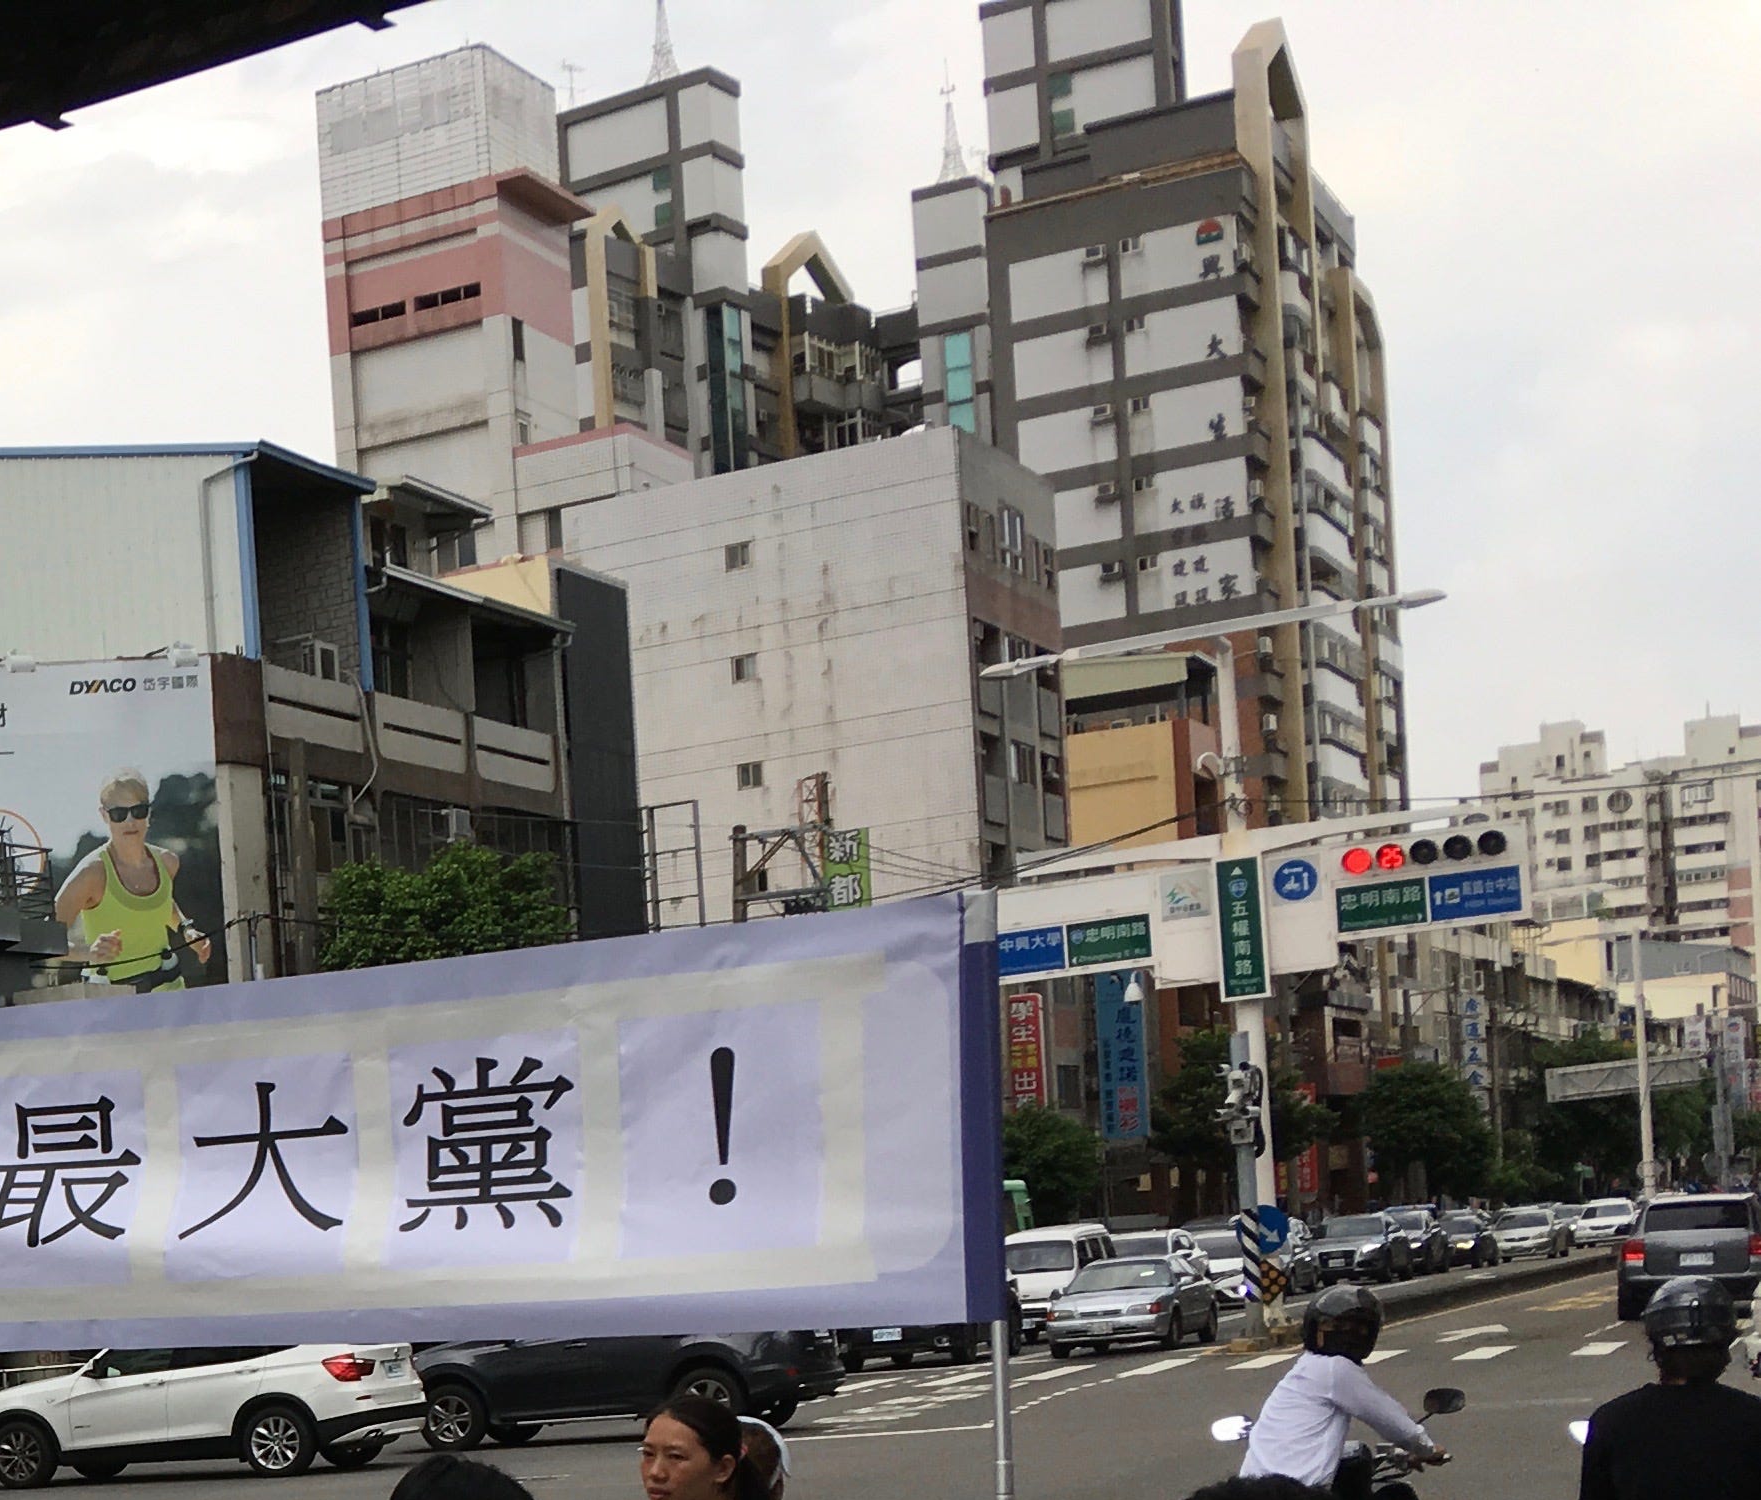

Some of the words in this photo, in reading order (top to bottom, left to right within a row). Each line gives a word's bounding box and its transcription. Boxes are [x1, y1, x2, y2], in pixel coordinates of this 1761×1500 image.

[69, 677, 137, 695] DYACO
[828, 830, 863, 905] 新都
[1381, 848, 1404, 868] 25
[1341, 885, 1422, 910] 忠明南路
[999, 932, 1062, 954] 中興大學
[1085, 921, 1147, 943] 忠明南路
[1231, 900, 1252, 976] 五權南路
